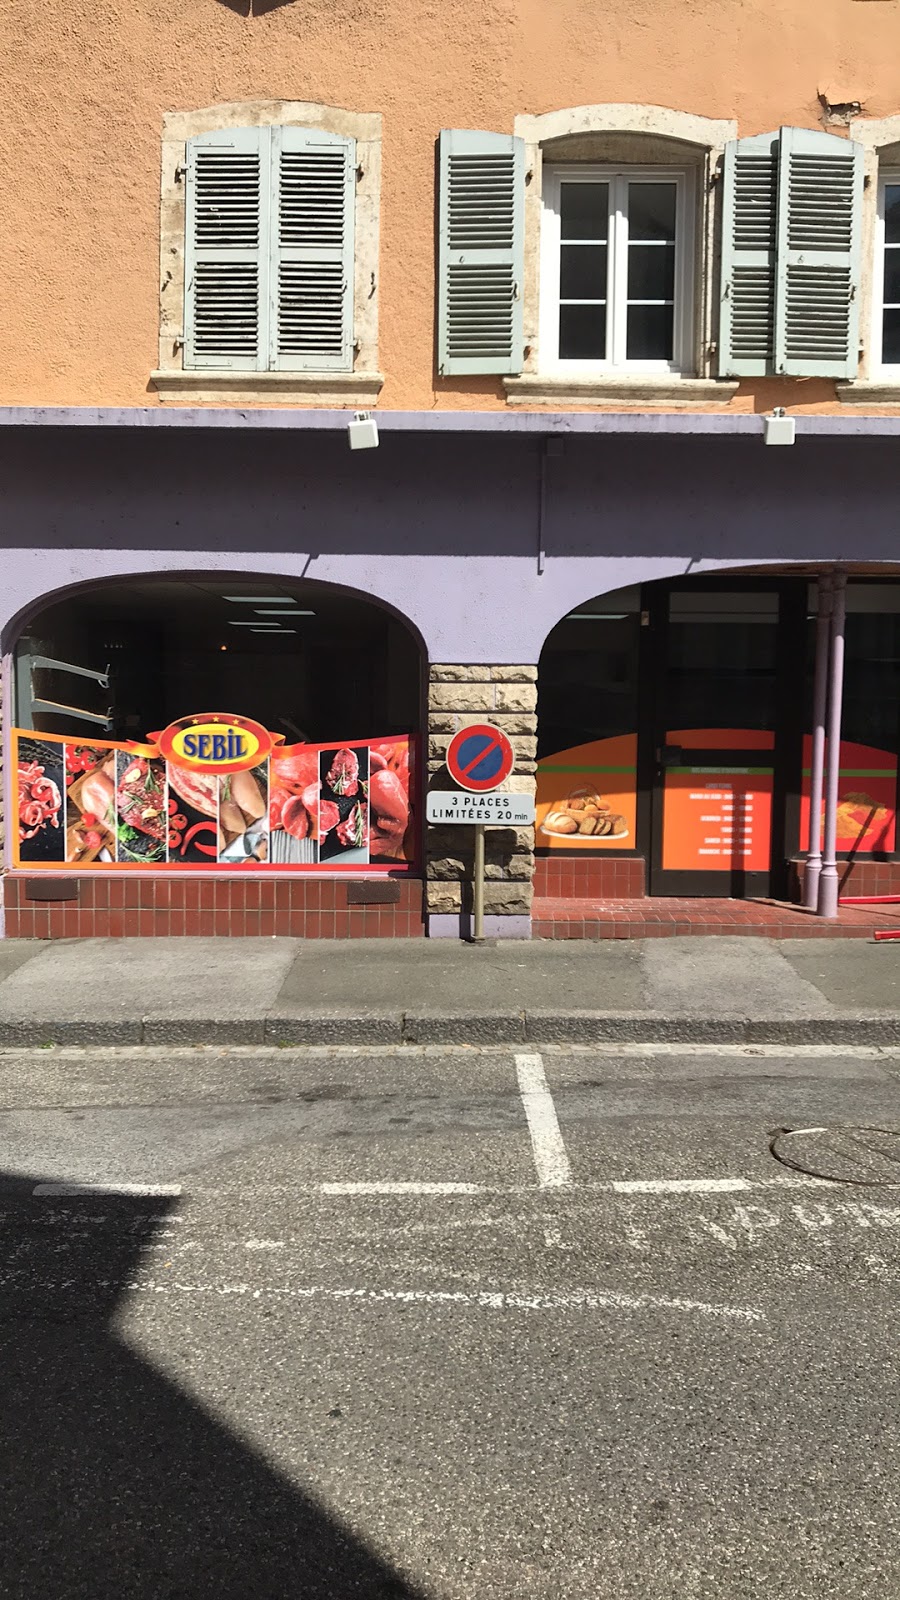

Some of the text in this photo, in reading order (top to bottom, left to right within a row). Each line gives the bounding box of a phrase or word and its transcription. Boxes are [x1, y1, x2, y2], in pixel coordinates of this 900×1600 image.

[452, 797, 510, 807] 3 PLACES
[432, 808, 491, 819] LIMITÉES
[497, 811, 512, 820] 20
